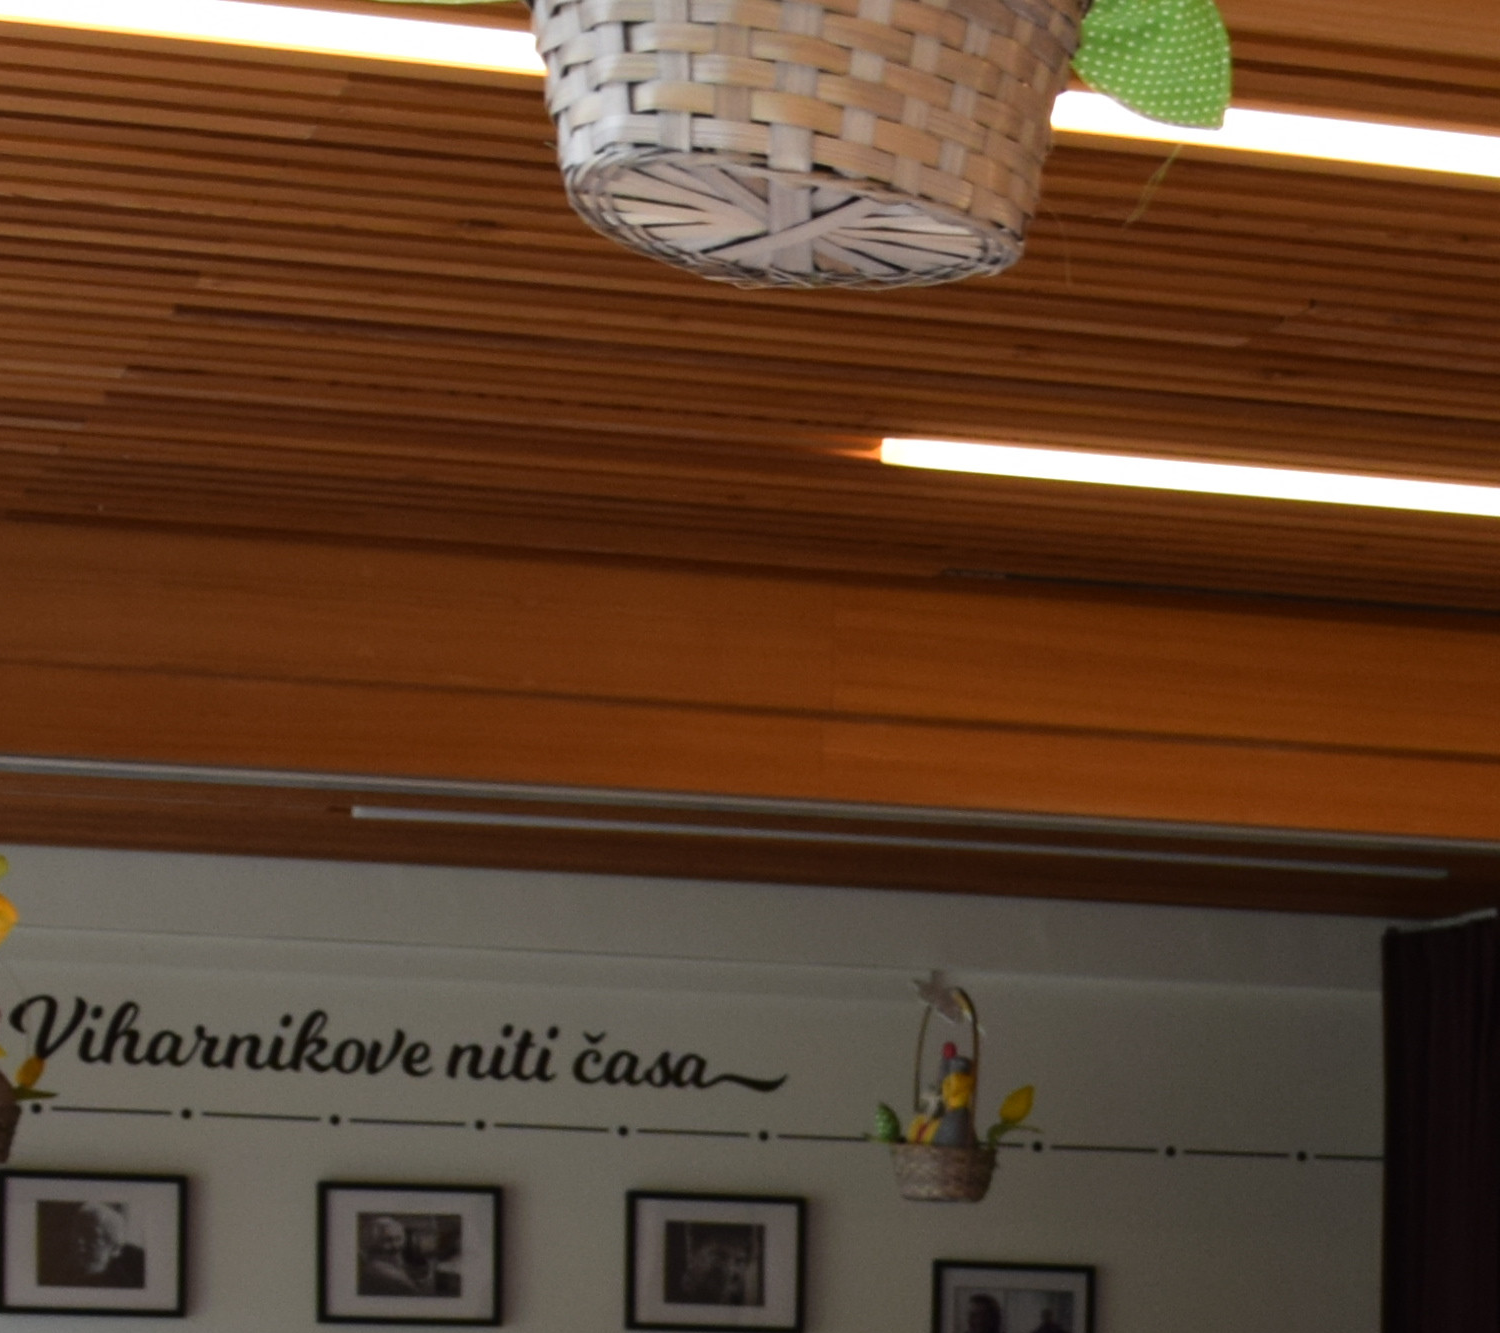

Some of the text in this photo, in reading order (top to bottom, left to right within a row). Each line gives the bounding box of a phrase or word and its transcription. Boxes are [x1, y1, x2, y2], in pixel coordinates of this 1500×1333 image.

[8, 994, 788, 1093] Viharnikove niti časa
